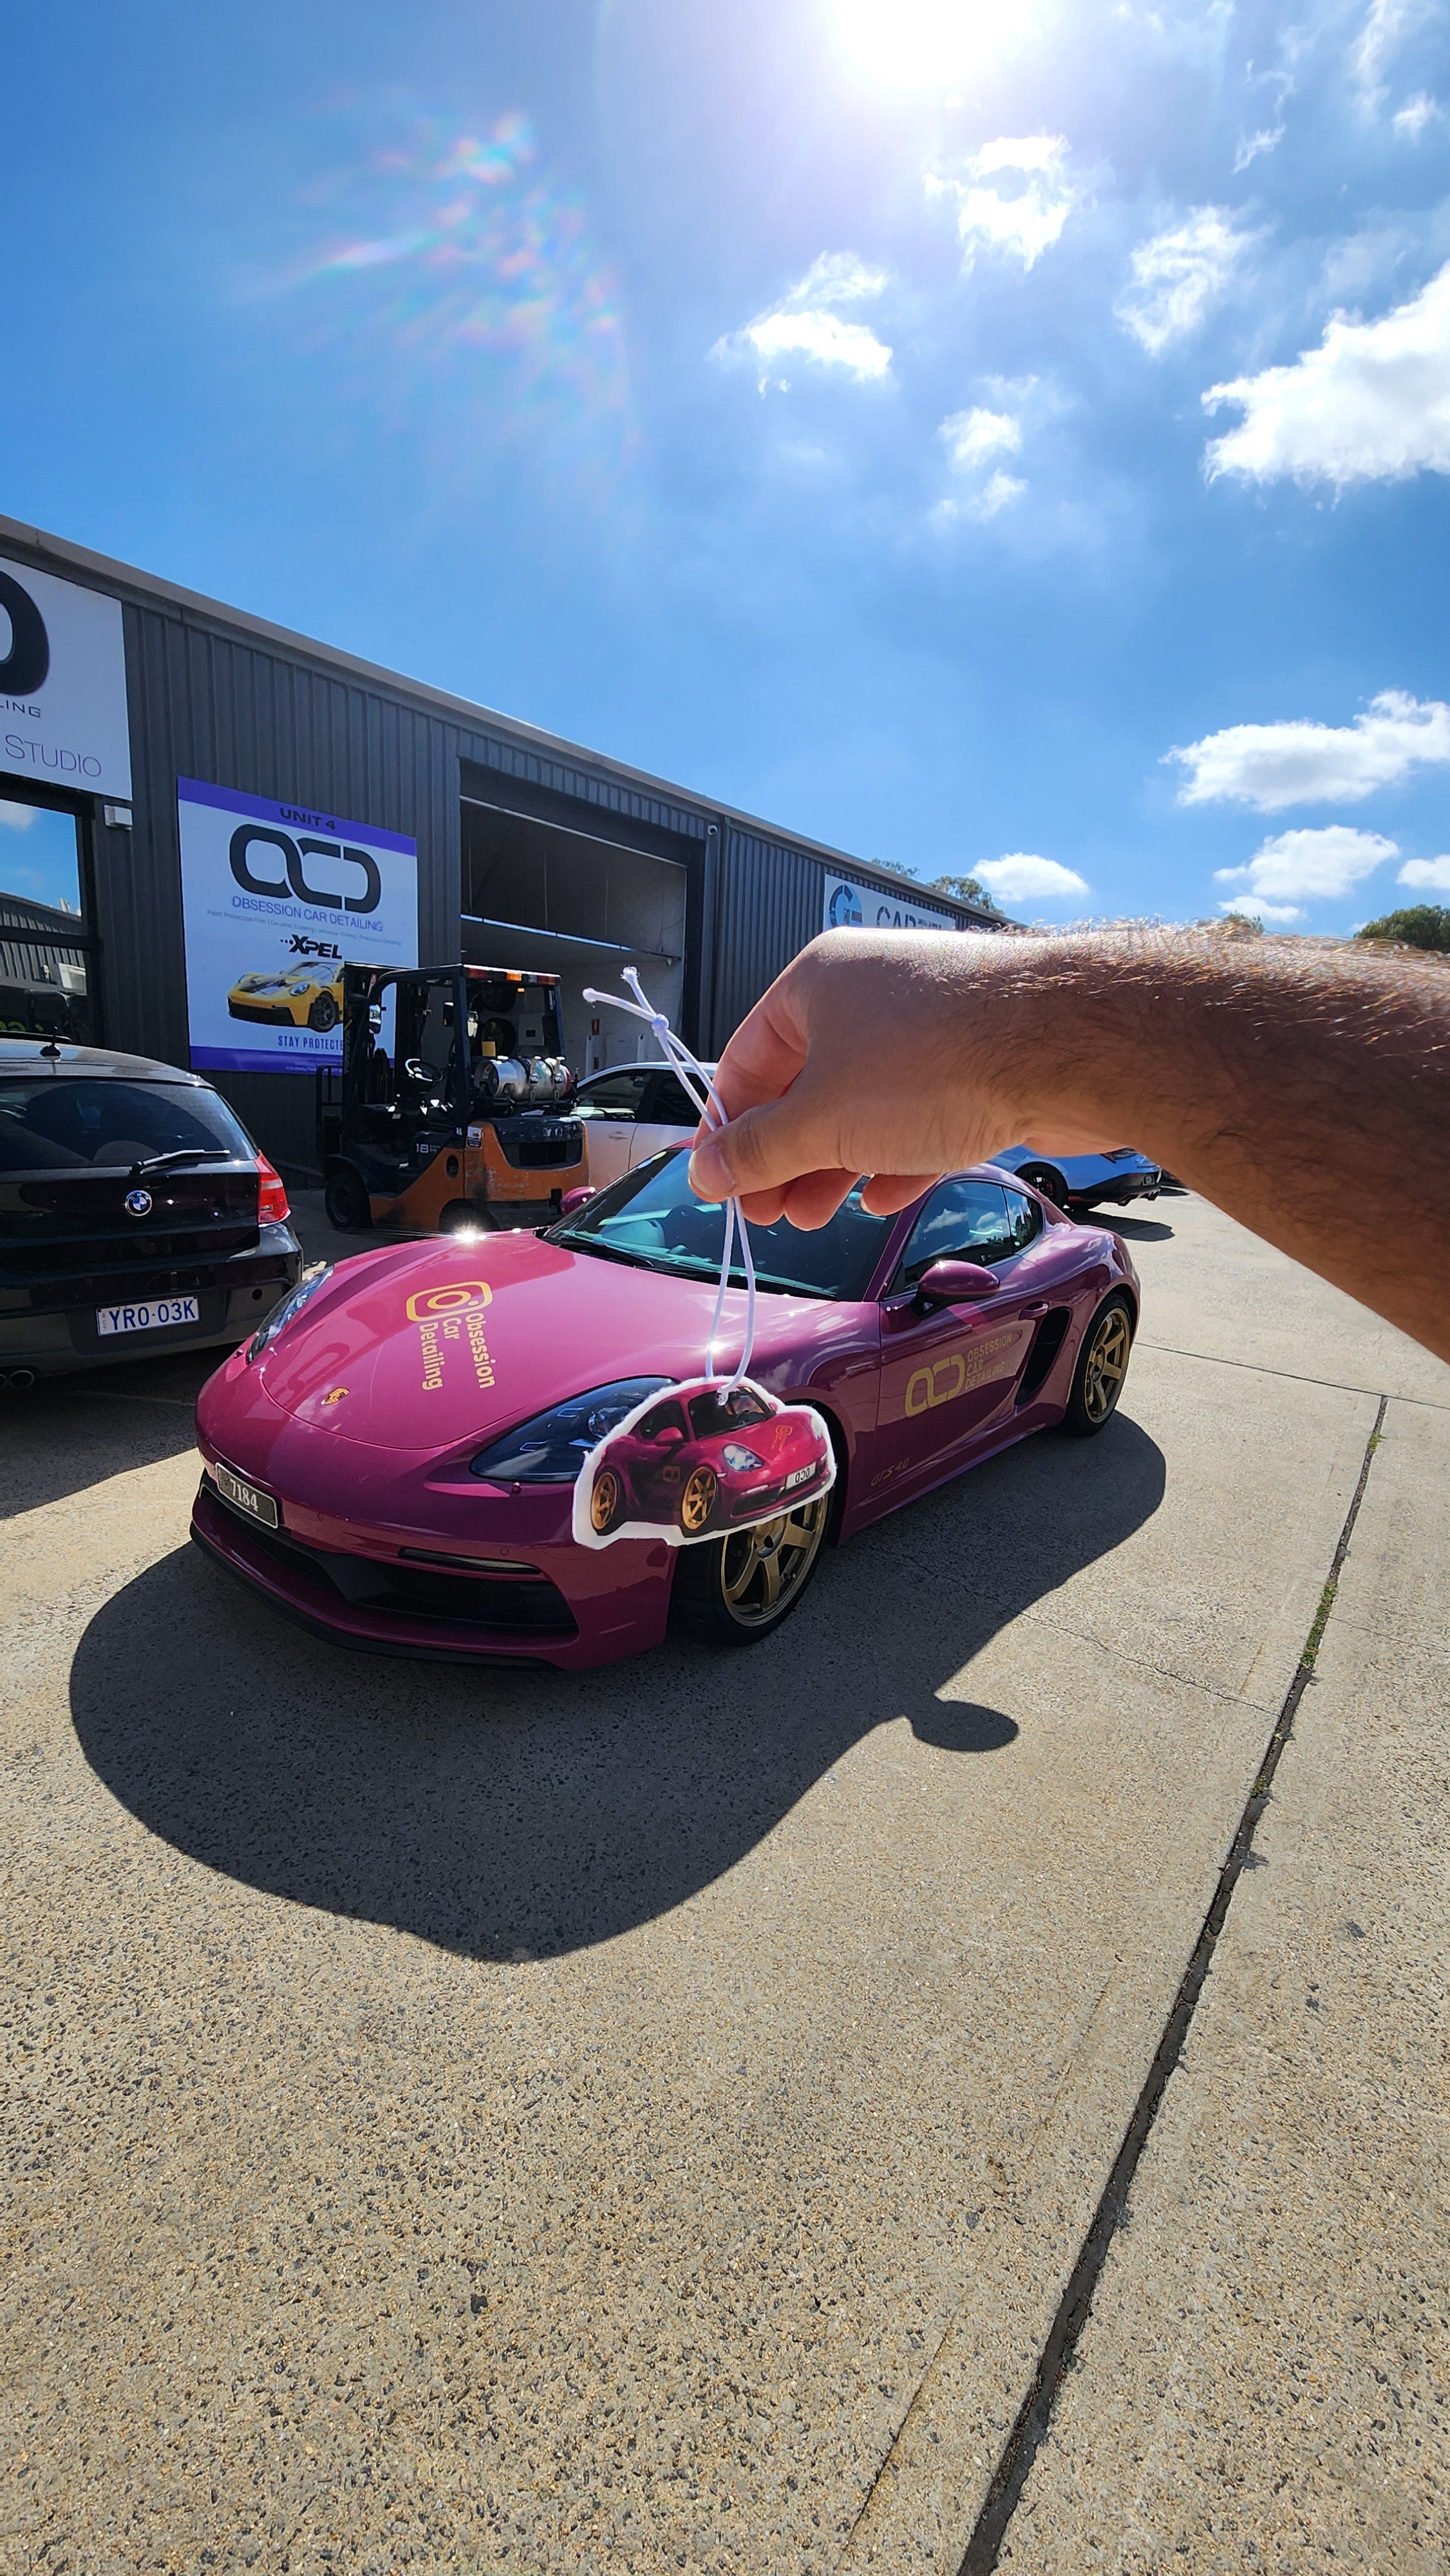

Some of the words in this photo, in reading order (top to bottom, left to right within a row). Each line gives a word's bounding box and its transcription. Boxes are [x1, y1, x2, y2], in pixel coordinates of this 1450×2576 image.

[5, 735, 102, 777] STUDIO
[279, 807, 322, 827] UNIT
[325, 819, 336, 830] 4
[232, 896, 301, 918] OBSESSION
[304, 909, 328, 923] CAR
[330, 913, 384, 932] DETAILING
[288, 934, 343, 960] XPEL
[278, 1035, 299, 1048] STAY
[303, 1037, 343, 1051] PROTECTE
[416, 1143, 429, 1153] 18
[442, 1317, 462, 1339] Car
[419, 1321, 446, 1390] Detailing
[466, 1312, 496, 1388] Obsession
[967, 1333, 1012, 1363] OBSESSION
[966, 1359, 984, 1376] CAR
[966, 1361, 1006, 1389] DETAILING
[871, 1465, 894, 1486] GTS
[229, 1478, 259, 1512] 7184
